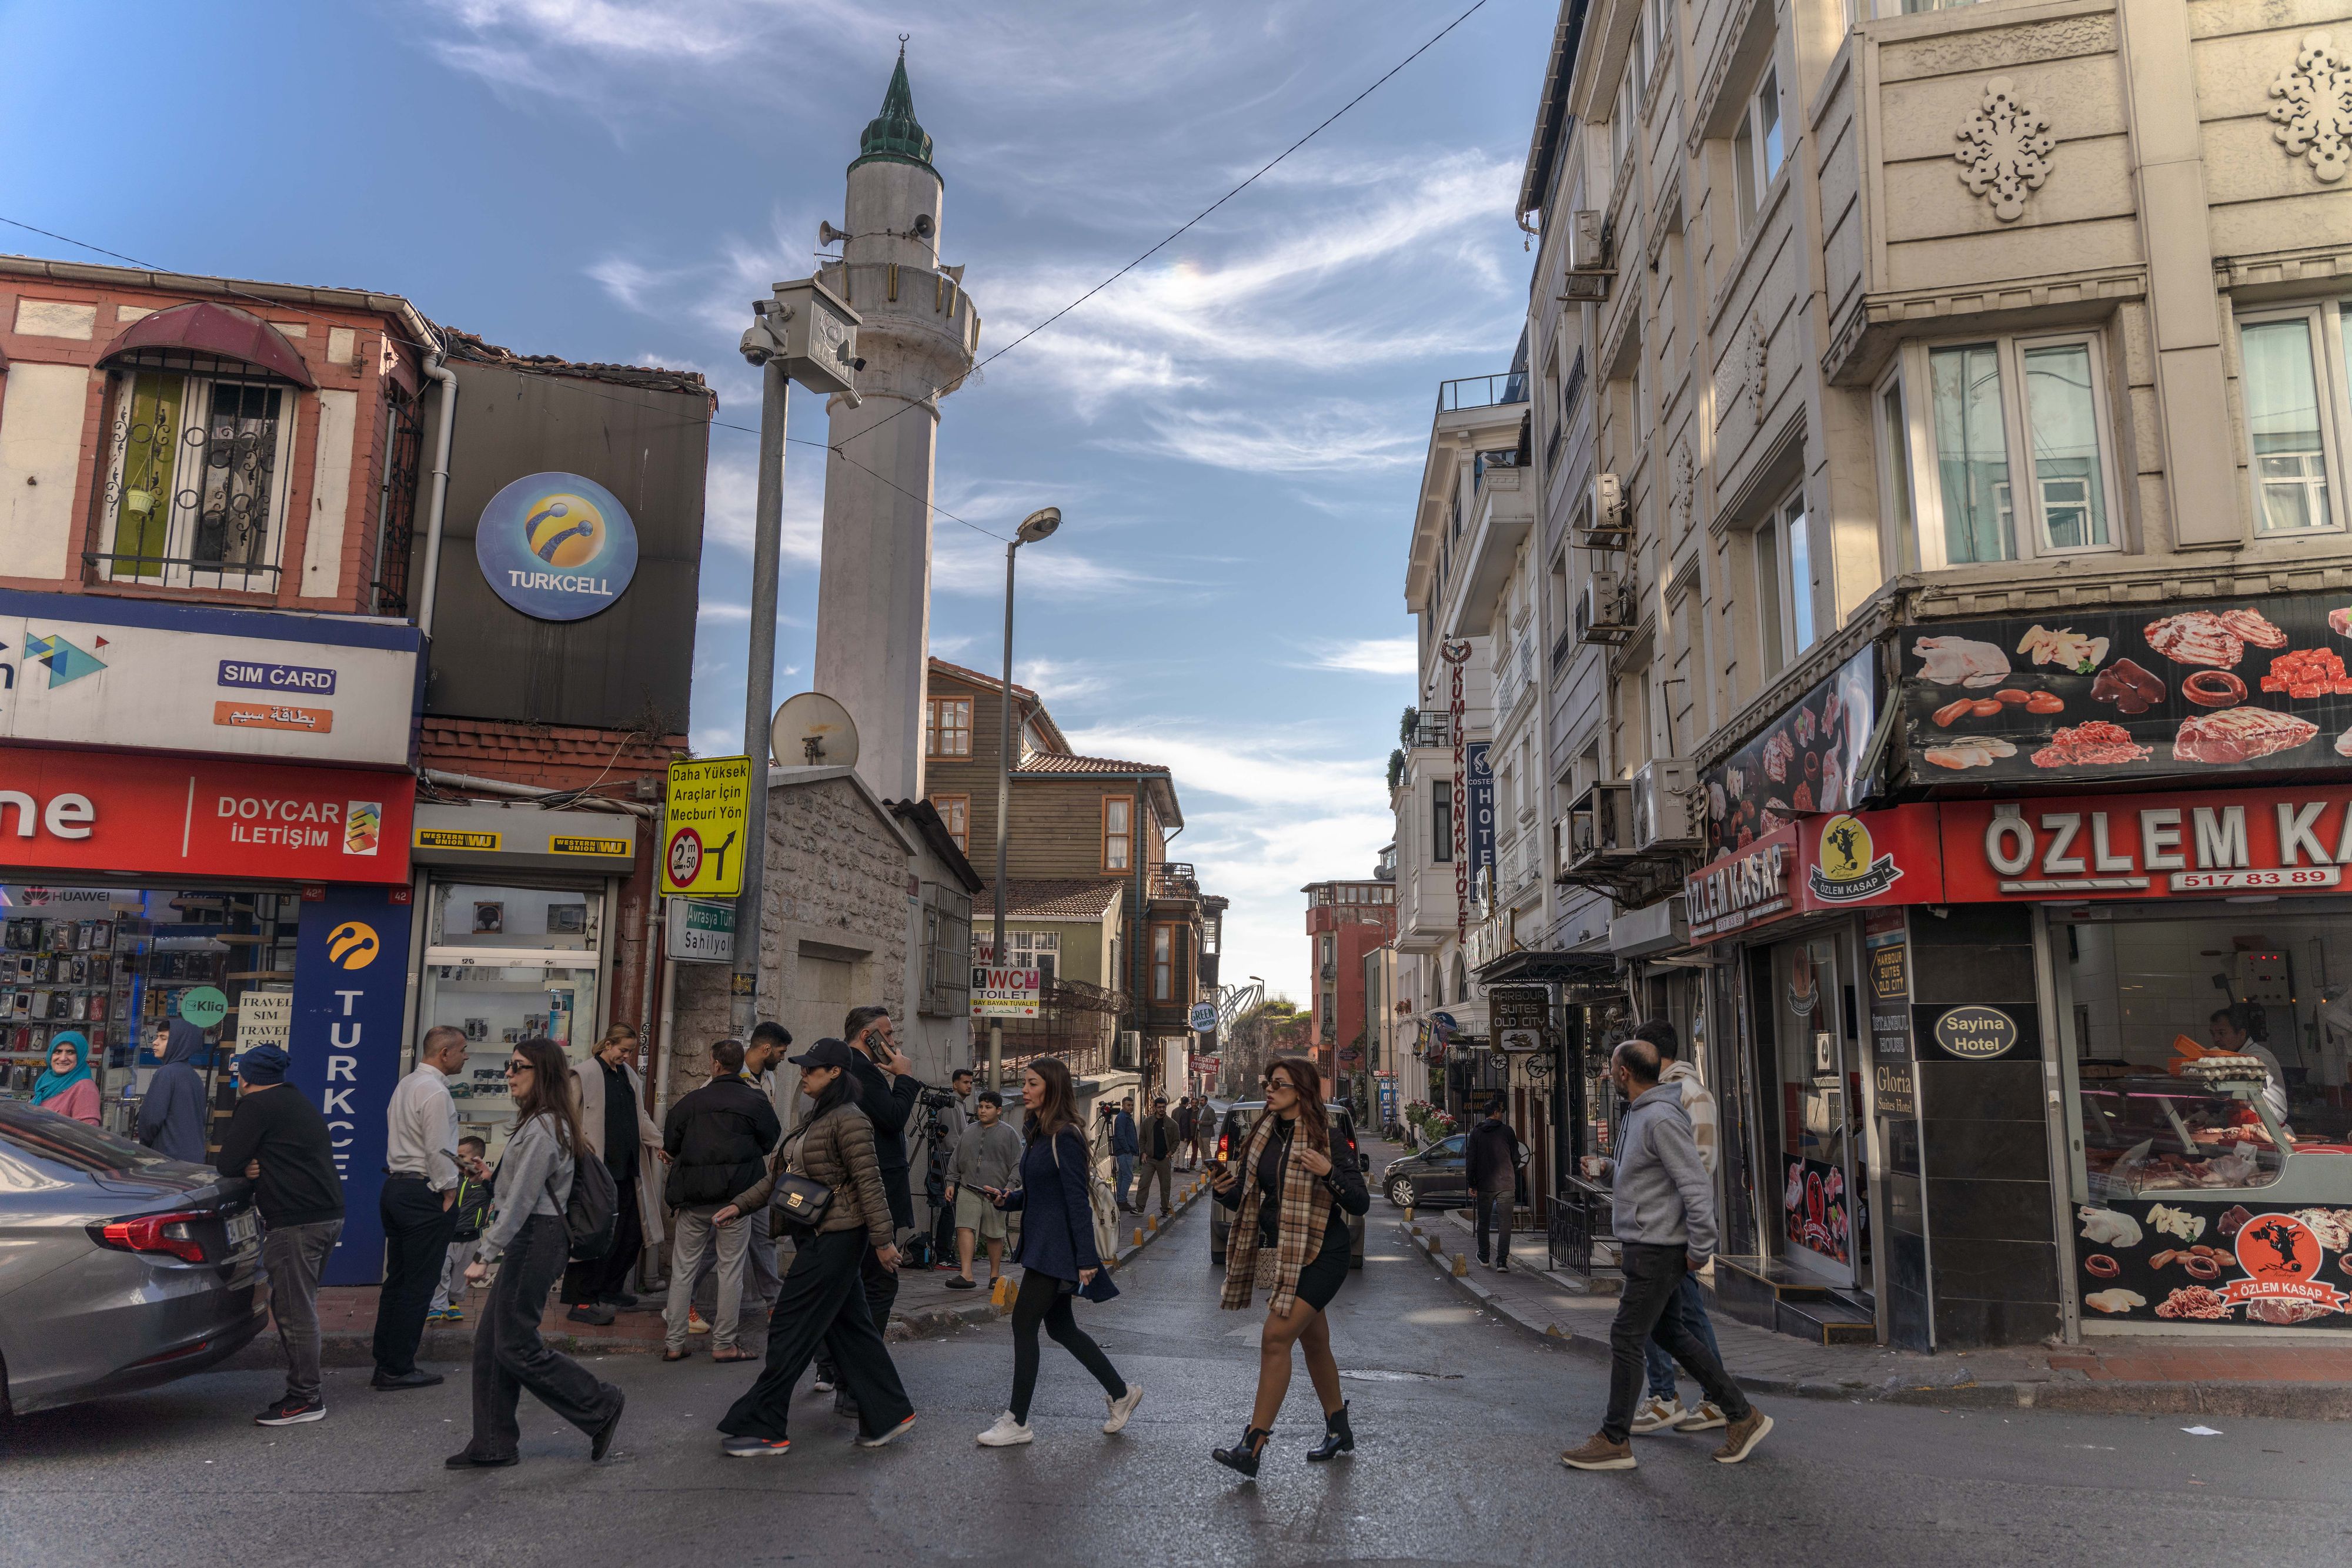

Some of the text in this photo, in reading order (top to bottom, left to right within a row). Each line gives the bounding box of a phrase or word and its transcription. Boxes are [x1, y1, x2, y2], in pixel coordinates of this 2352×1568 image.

[508, 570, 613, 596] TURKCELL
[224, 665, 332, 688] SIM CARD
[230, 707, 316, 728] بطاقة سيم
[673, 765, 747, 782] Daha Yüksek
[674, 783, 741, 803] Araçlar İçin
[218, 797, 339, 824] DOYCAR
[1449, 666, 1468, 944] KUMLUK KONAK HOTEL
[671, 806, 741, 821] Mecburi Yön
[1479, 788, 1491, 865] HOTE
[231, 822, 329, 850] İLETİŞİM
[469, 835, 492, 847] WU
[1985, 801, 2352, 876] ÖZLEM K
[600, 841, 622, 853] WU
[1685, 842, 1786, 926] ÖZLEM KASAP
[1820, 877, 1878, 895] ÖZLEM KASAP
[2184, 871, 2326, 887] 517 83 89
[52, 891, 110, 902] HUAWEI
[395, 892, 407, 901] 42
[687, 906, 717, 928] Avrasya
[1718, 914, 1742, 930] 517 83 89
[1877, 951, 1903, 966] HARBOUR
[987, 970, 1024, 989] WC
[1881, 965, 1900, 979] SUITES
[1879, 977, 1904, 992] OLD CITY
[978, 990, 1030, 999] TOILET
[1492, 990, 1545, 1001] HARBOUR
[198, 1001, 224, 1014] Kliq
[242, 998, 293, 1007] TRAVEL
[1500, 1004, 1538, 1014] SUITES
[253, 1011, 278, 1020] SIM
[986, 1006, 1020, 1016] الحمام
[1191, 1008, 1214, 1022] GREEN
[1197, 1018, 1216, 1028] MANSION
[1494, 1016, 1545, 1027] OLD CITY
[1872, 1013, 1909, 1031] İSTANBUL
[1947, 1016, 2004, 1034] Sayina
[239, 1027, 290, 1035] TRAVEL
[245, 1039, 282, 1048] E-SIM
[1879, 1037, 1905, 1052] HOUSE
[1955, 1037, 2000, 1051] Hotel
[1191, 1061, 1217, 1072] OTOPARK
[1194, 1055, 1215, 1064] SEÇKİN
[1877, 1066, 1912, 1094] Gloria
[1878, 1097, 1913, 1114] Suites Hotel
[2240, 1282, 2323, 1299] ÖZLEM KASAP
